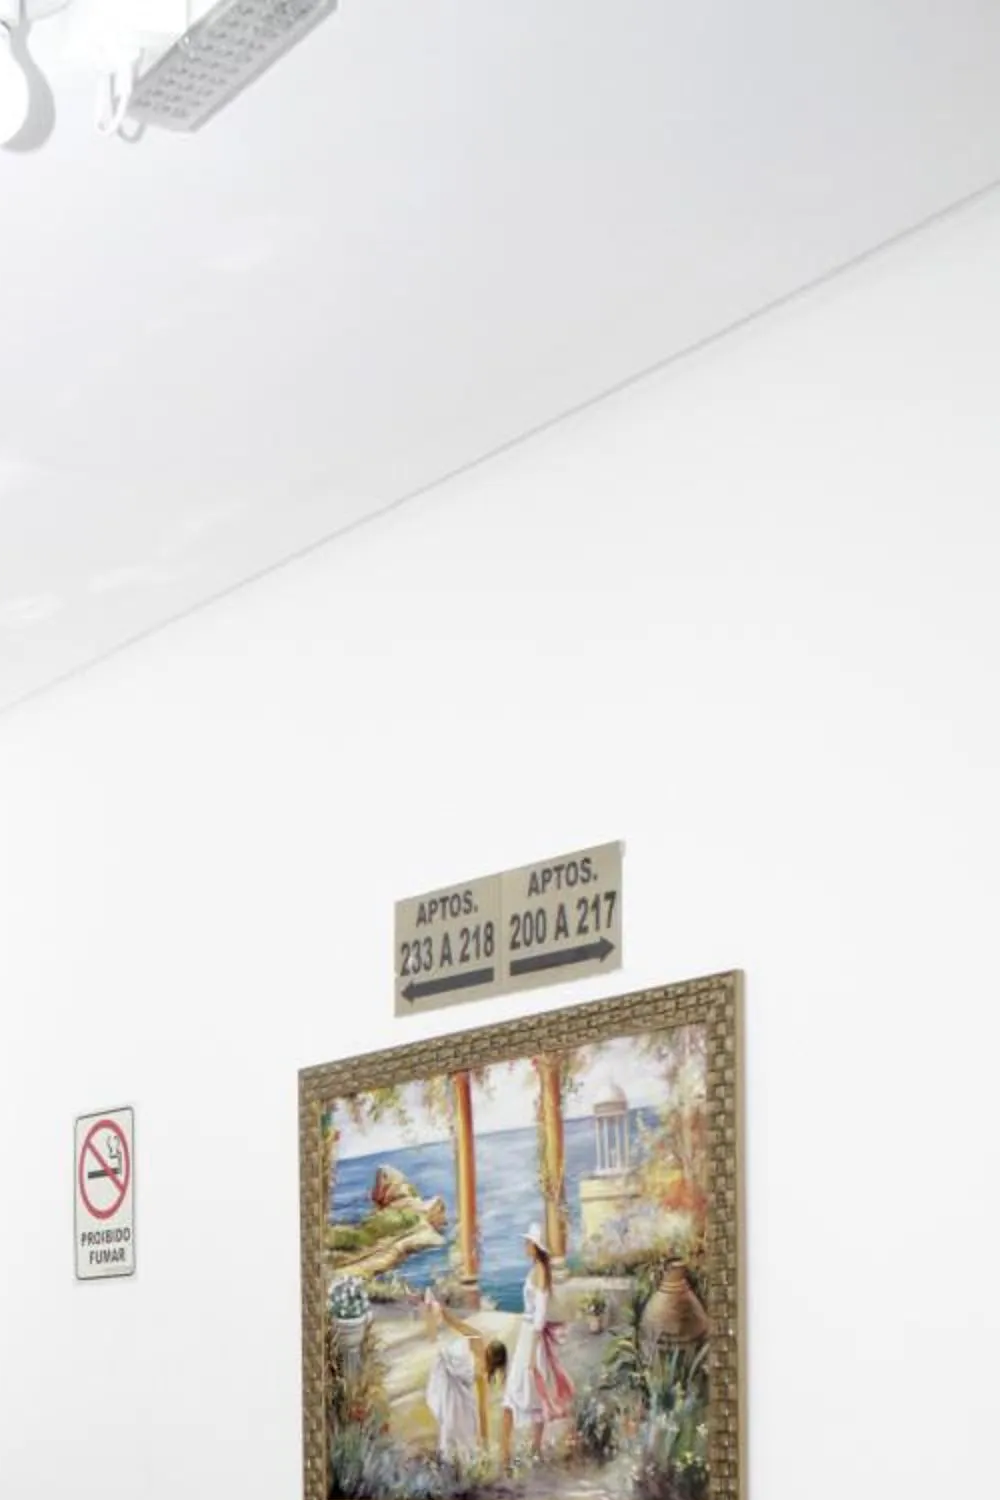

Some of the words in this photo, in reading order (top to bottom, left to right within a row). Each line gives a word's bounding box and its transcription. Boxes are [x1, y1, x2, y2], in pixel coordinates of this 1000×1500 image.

[527, 857, 598, 896] APTOS.
[416, 890, 478, 927] APTOS.
[509, 907, 547, 950] 200
[554, 903, 569, 940] A
[576, 891, 617, 935] 217
[400, 937, 433, 976] 233
[440, 932, 453, 967] A
[459, 921, 494, 962] 218
[89, 1247, 126, 1264] FUMAR
